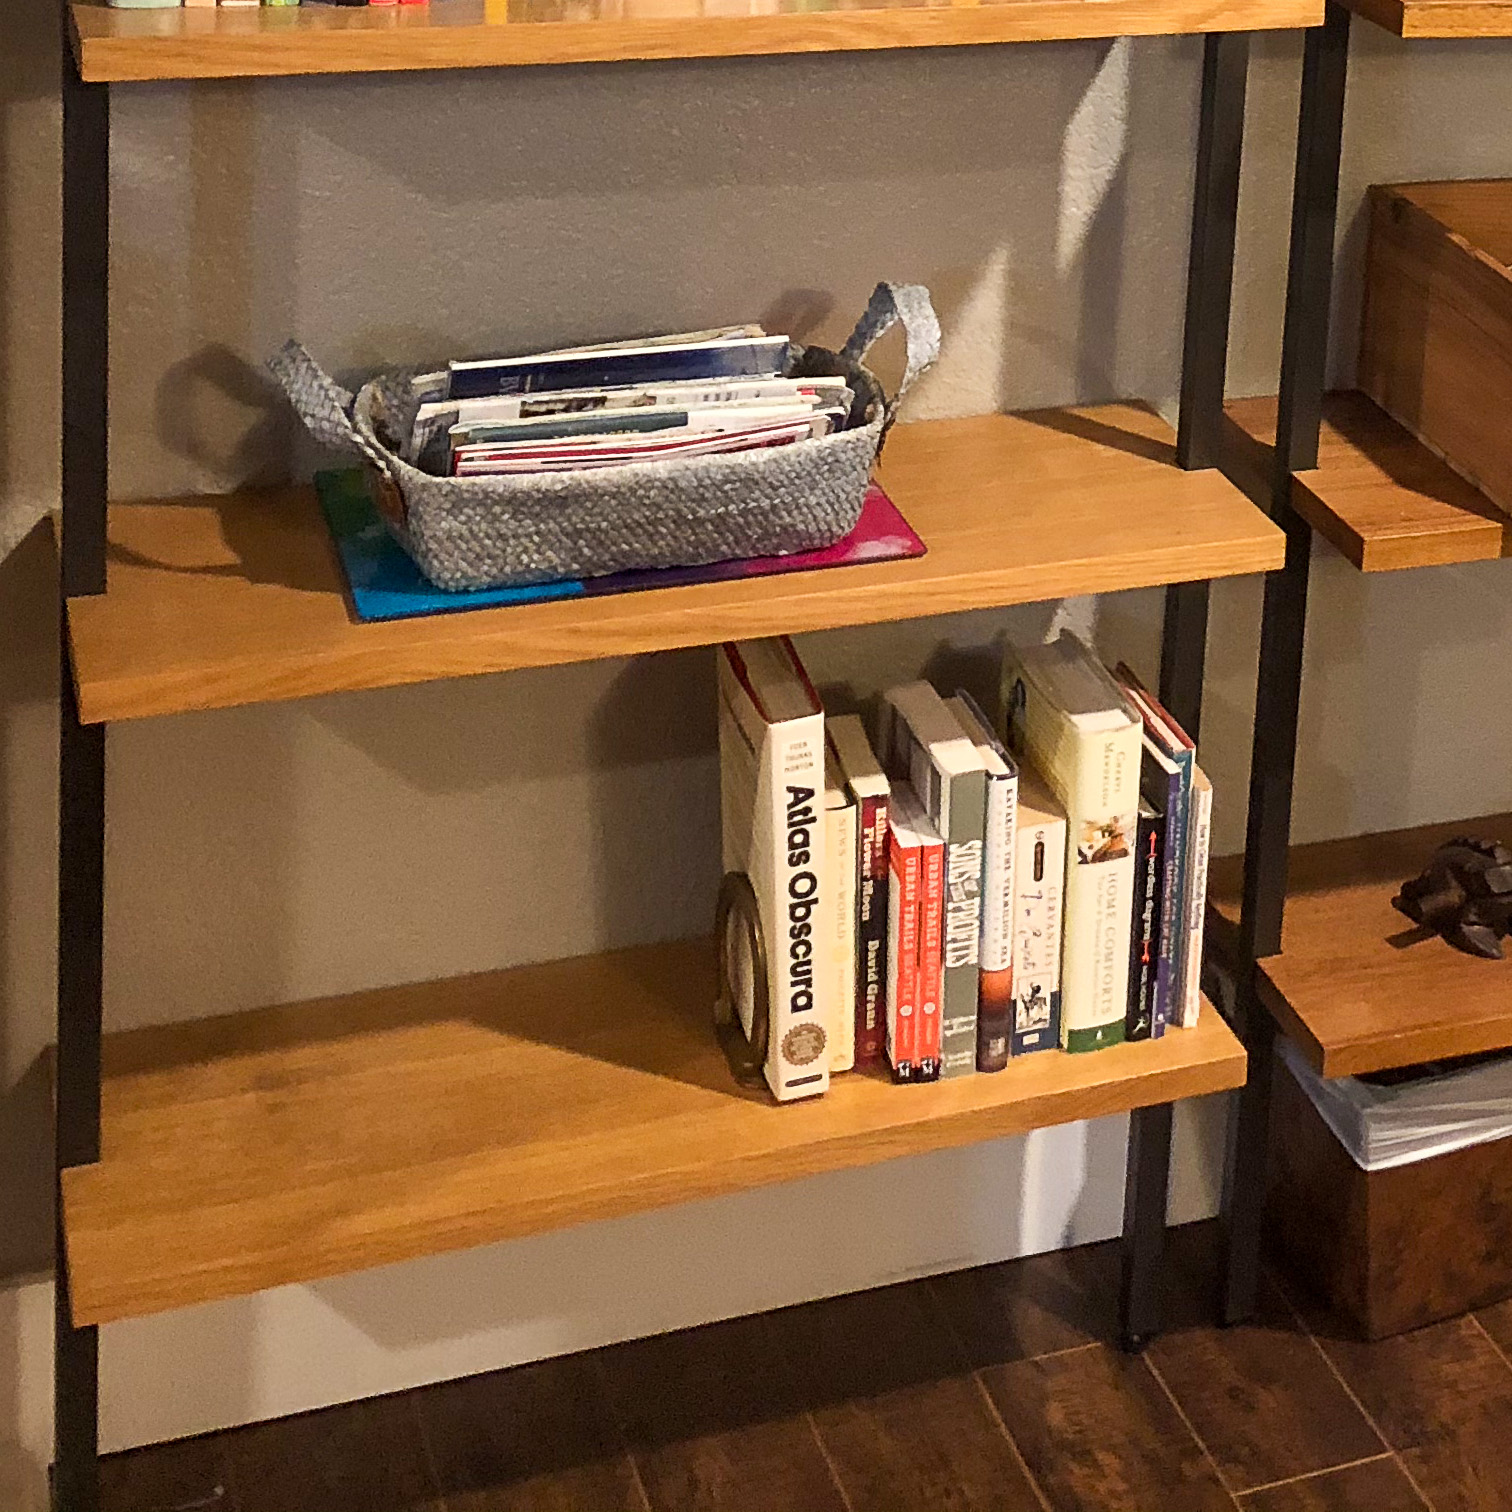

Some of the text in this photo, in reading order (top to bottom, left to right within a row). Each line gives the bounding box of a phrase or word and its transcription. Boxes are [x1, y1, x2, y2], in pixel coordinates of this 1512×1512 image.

[861, 827, 874, 921] Flower Moon
[875, 807, 887, 857] Killers
[948, 841, 982, 884] SONS
[1000, 789, 1013, 964] KAYAKING THE VERMILION SEA
[1199, 824, 1207, 838] How
[786, 786, 819, 1014] Atlas Obscura
[903, 857, 918, 949] URBAN TRAILS
[927, 854, 939, 947] URBAN TRAILS
[946, 897, 981, 968] PROFITS
[1046, 887, 1056, 967] CERVANTES
[1101, 872, 1118, 1015] HOME COMFORTS
[866, 940, 880, 1030] David Grann
